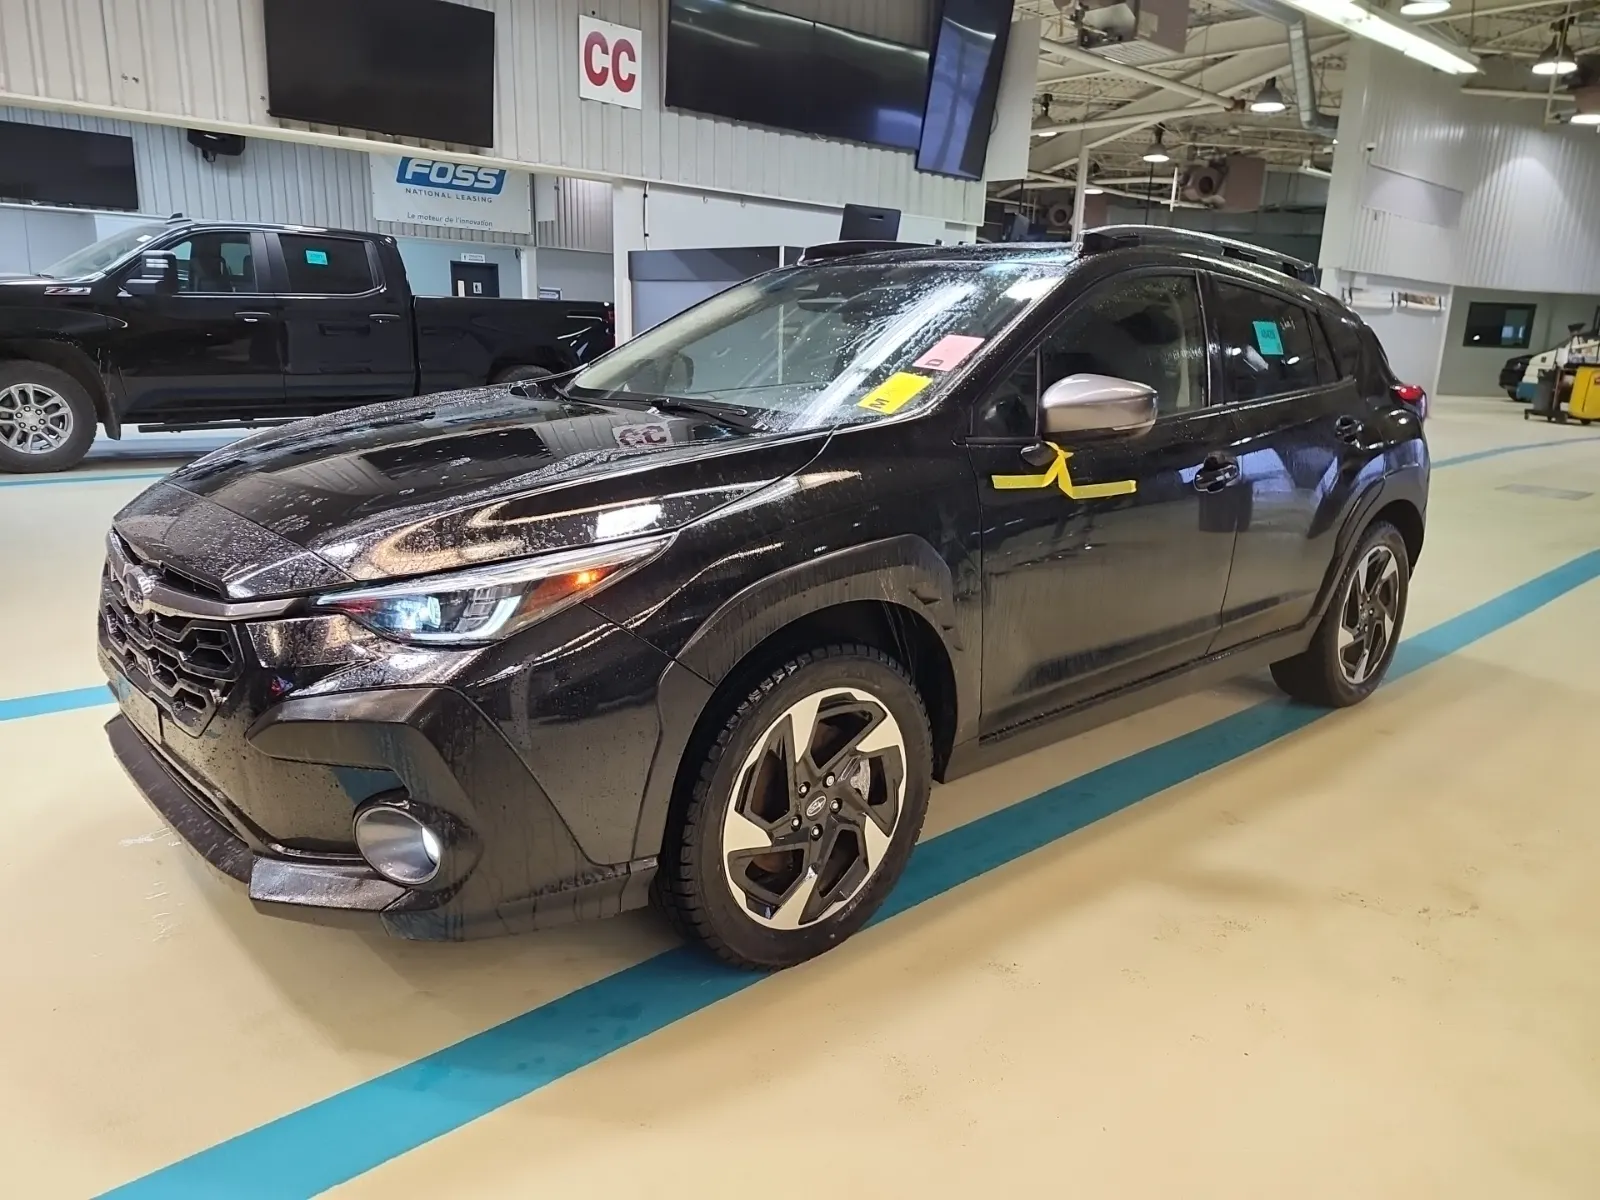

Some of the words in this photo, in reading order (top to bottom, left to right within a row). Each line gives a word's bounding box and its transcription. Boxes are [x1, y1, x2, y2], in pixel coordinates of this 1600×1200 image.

[584, 31, 636, 93] CC
[405, 159, 500, 189] FOSS
[405, 188, 452, 199] NATIONAL
[456, 194, 493, 203] LEASING
[407, 211, 416, 219] Le
[418, 213, 442, 222] moteur
[444, 214, 454, 222] de
[455, 215, 493, 227] l'innovation
